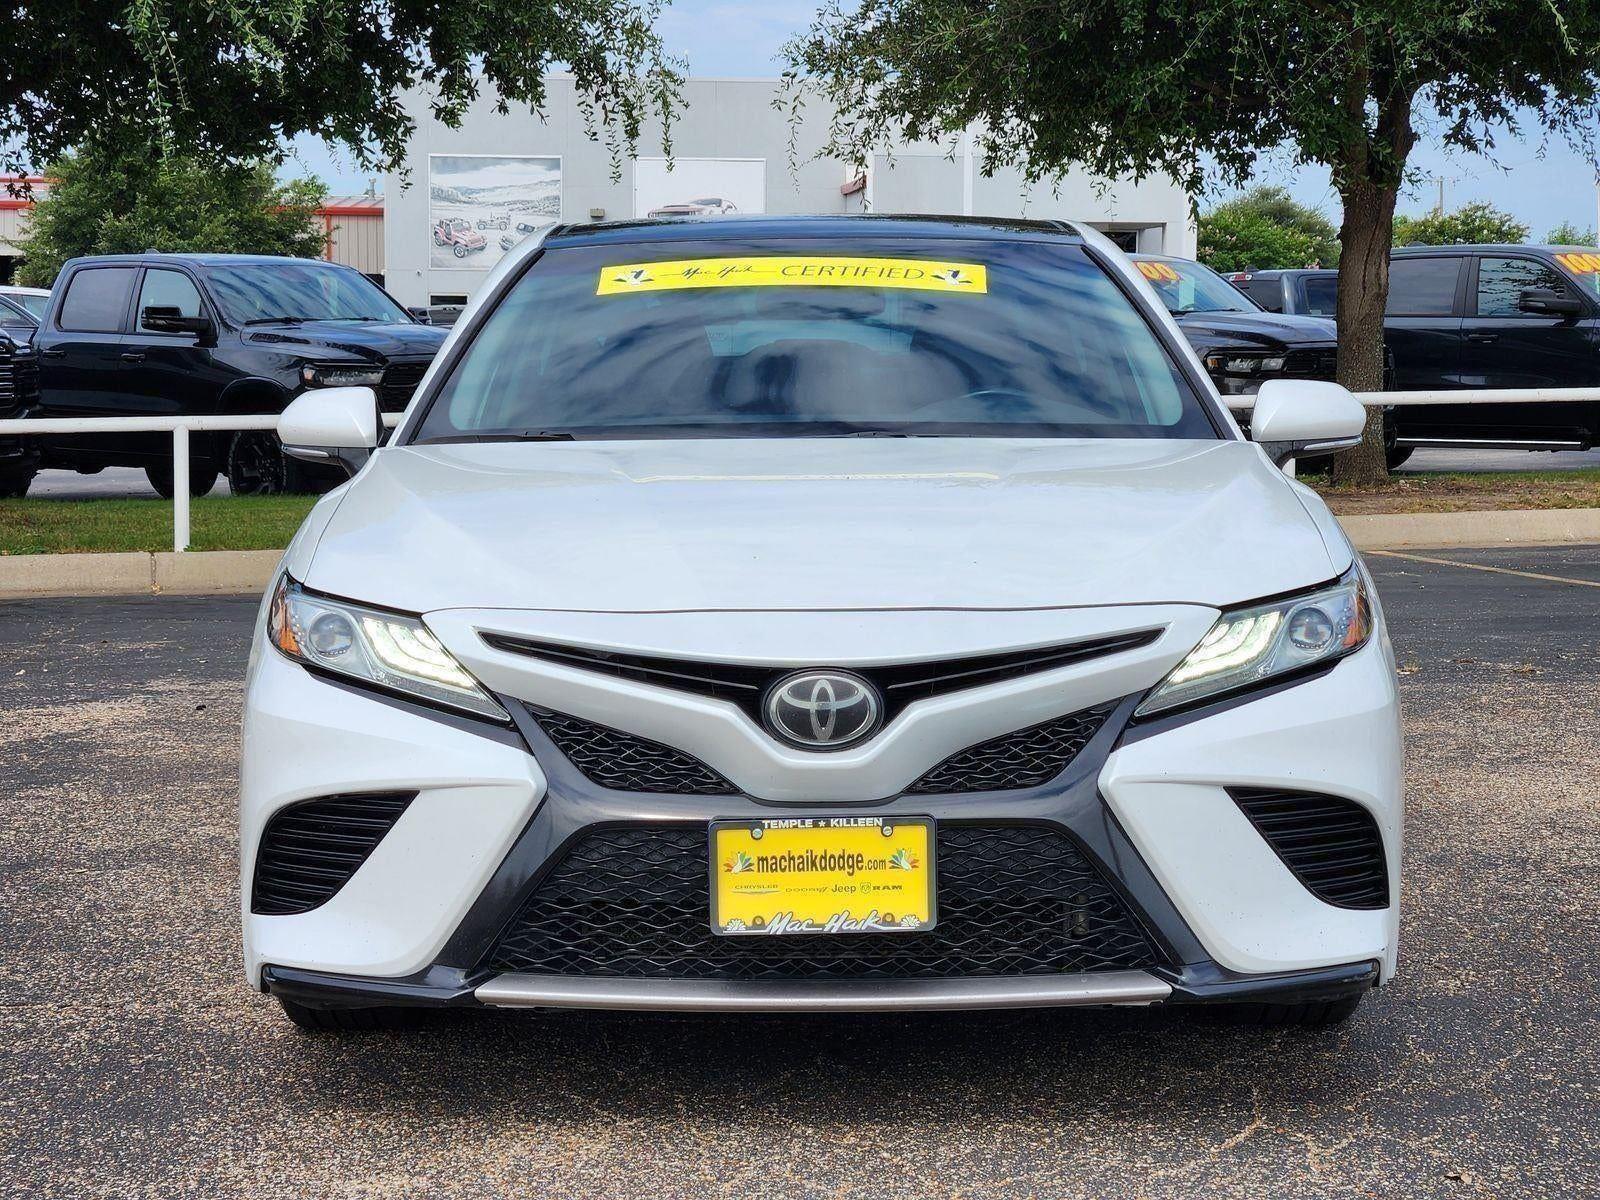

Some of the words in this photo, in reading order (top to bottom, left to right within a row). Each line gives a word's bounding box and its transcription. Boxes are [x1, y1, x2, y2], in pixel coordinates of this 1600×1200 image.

[781, 264, 925, 280] CERTIFIED
[762, 818, 813, 829] TEMPLE
[830, 817, 883, 827] KILLEEN
[757, 849, 887, 876] machaikdodge.com
[831, 884, 857, 893] Jeep
[765, 910, 822, 934] Mac
[824, 909, 882, 933] Haik
